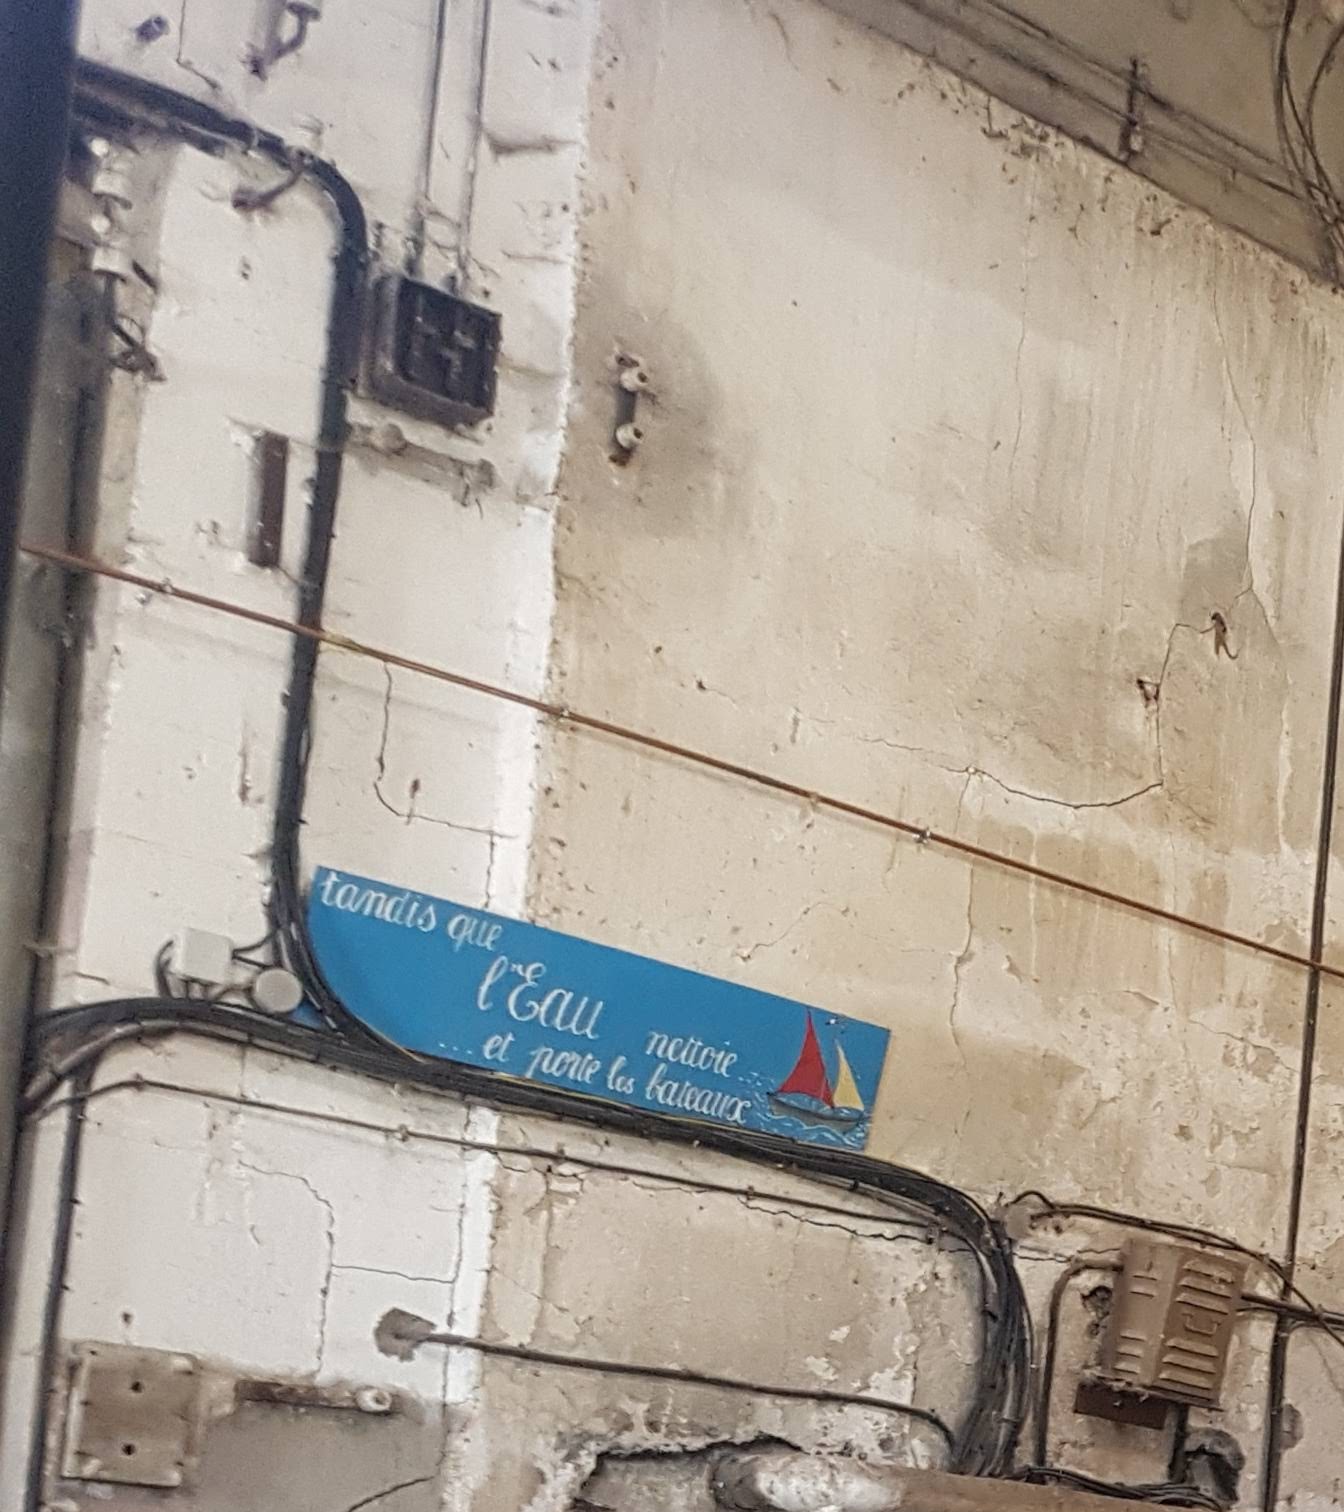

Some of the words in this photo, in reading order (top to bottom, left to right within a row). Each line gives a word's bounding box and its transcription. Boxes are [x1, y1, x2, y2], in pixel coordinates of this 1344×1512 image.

[319, 871, 437, 932] tandis
[447, 913, 503, 951] que
[483, 1032, 509, 1062] et
[525, 1046, 602, 1082] porte
[607, 1055, 636, 1094] les
[646, 1062, 751, 1124] bateaux
[646, 1030, 738, 1078] nettoie
